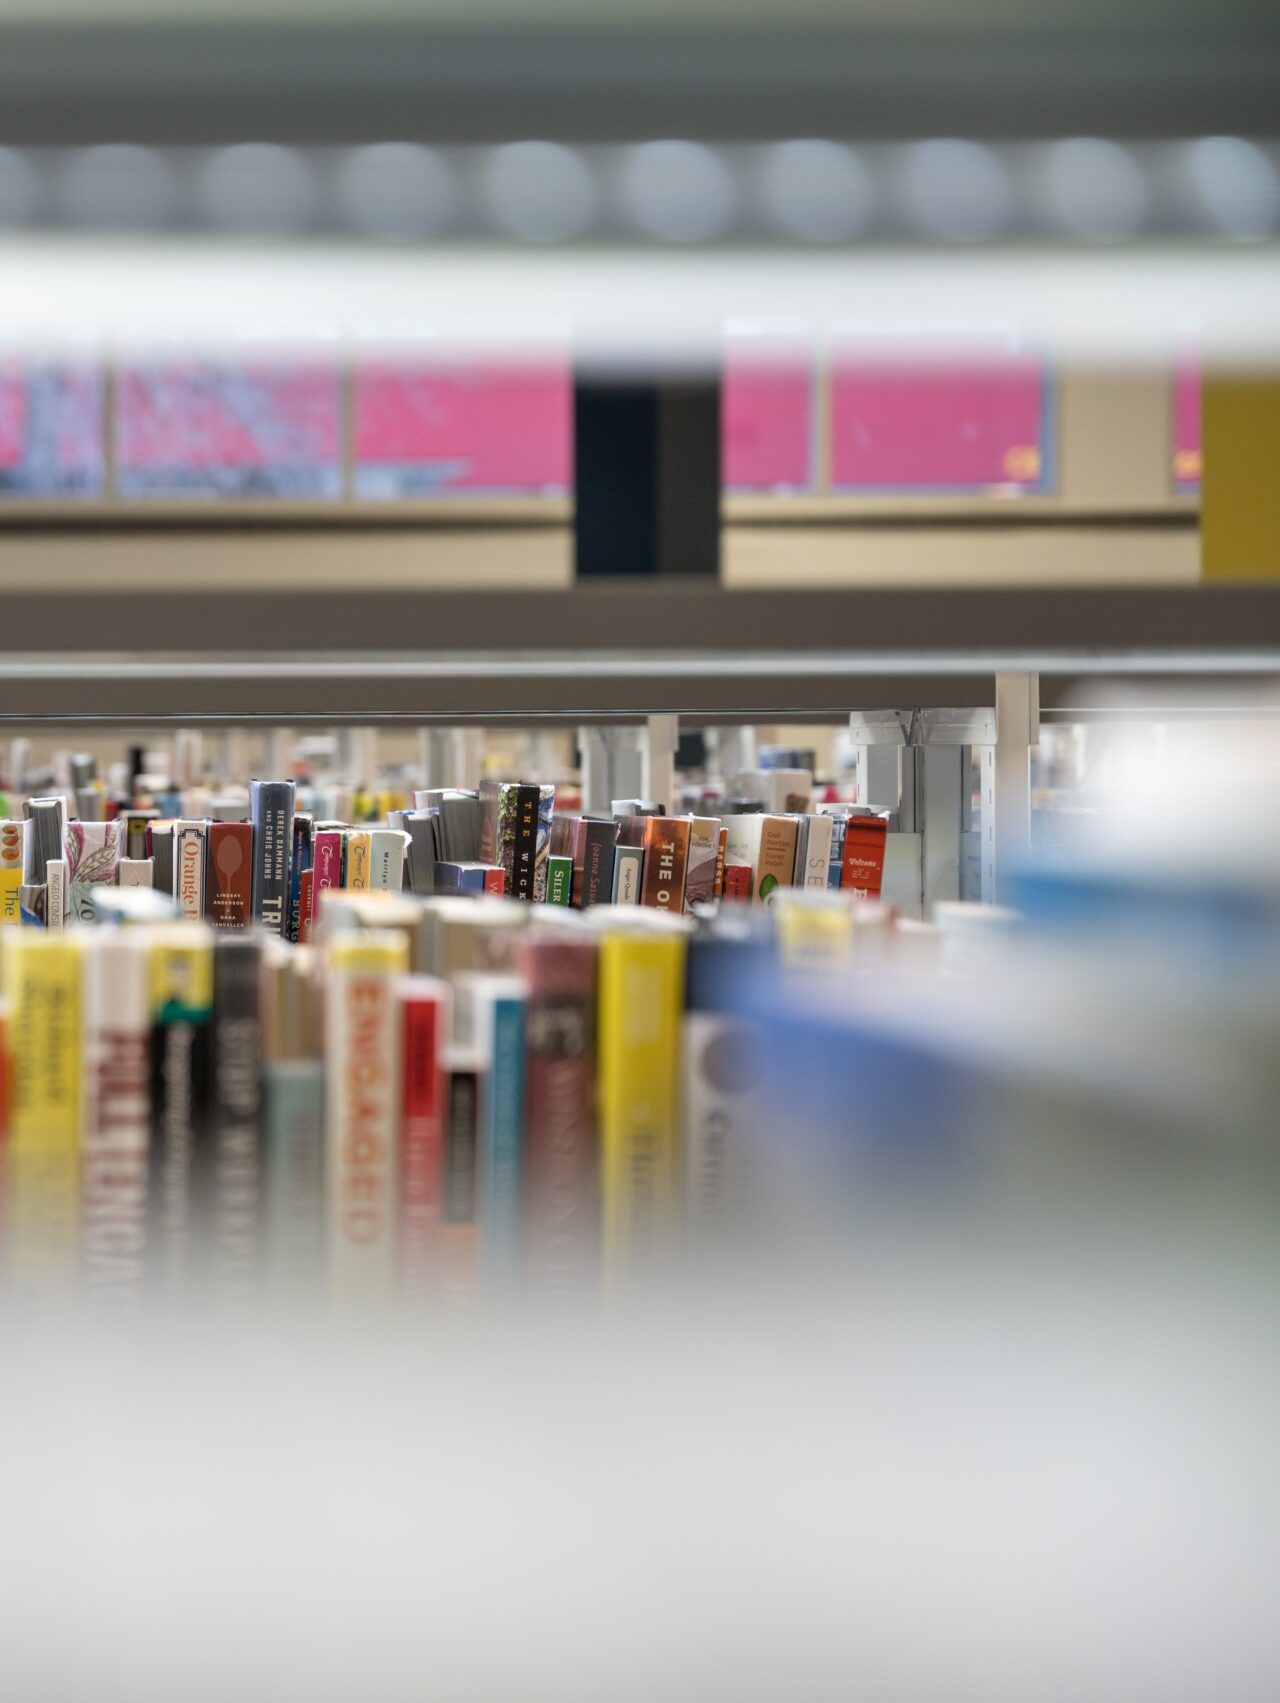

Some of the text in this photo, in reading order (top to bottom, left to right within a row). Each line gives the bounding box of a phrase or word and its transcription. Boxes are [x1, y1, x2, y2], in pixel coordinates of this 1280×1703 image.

[523, 801, 533, 837] THE
[265, 825, 273, 849] CHRIS
[275, 809, 285, 880] DEREK DAMMANN
[182, 841, 203, 904] Orange
[263, 852, 272, 879] JOHNS
[591, 843, 602, 875] Joanne
[658, 842, 675, 880] THE
[4, 887, 20, 916] The
[52, 873, 60, 900] ANGELO
[553, 870, 564, 902] SILER
